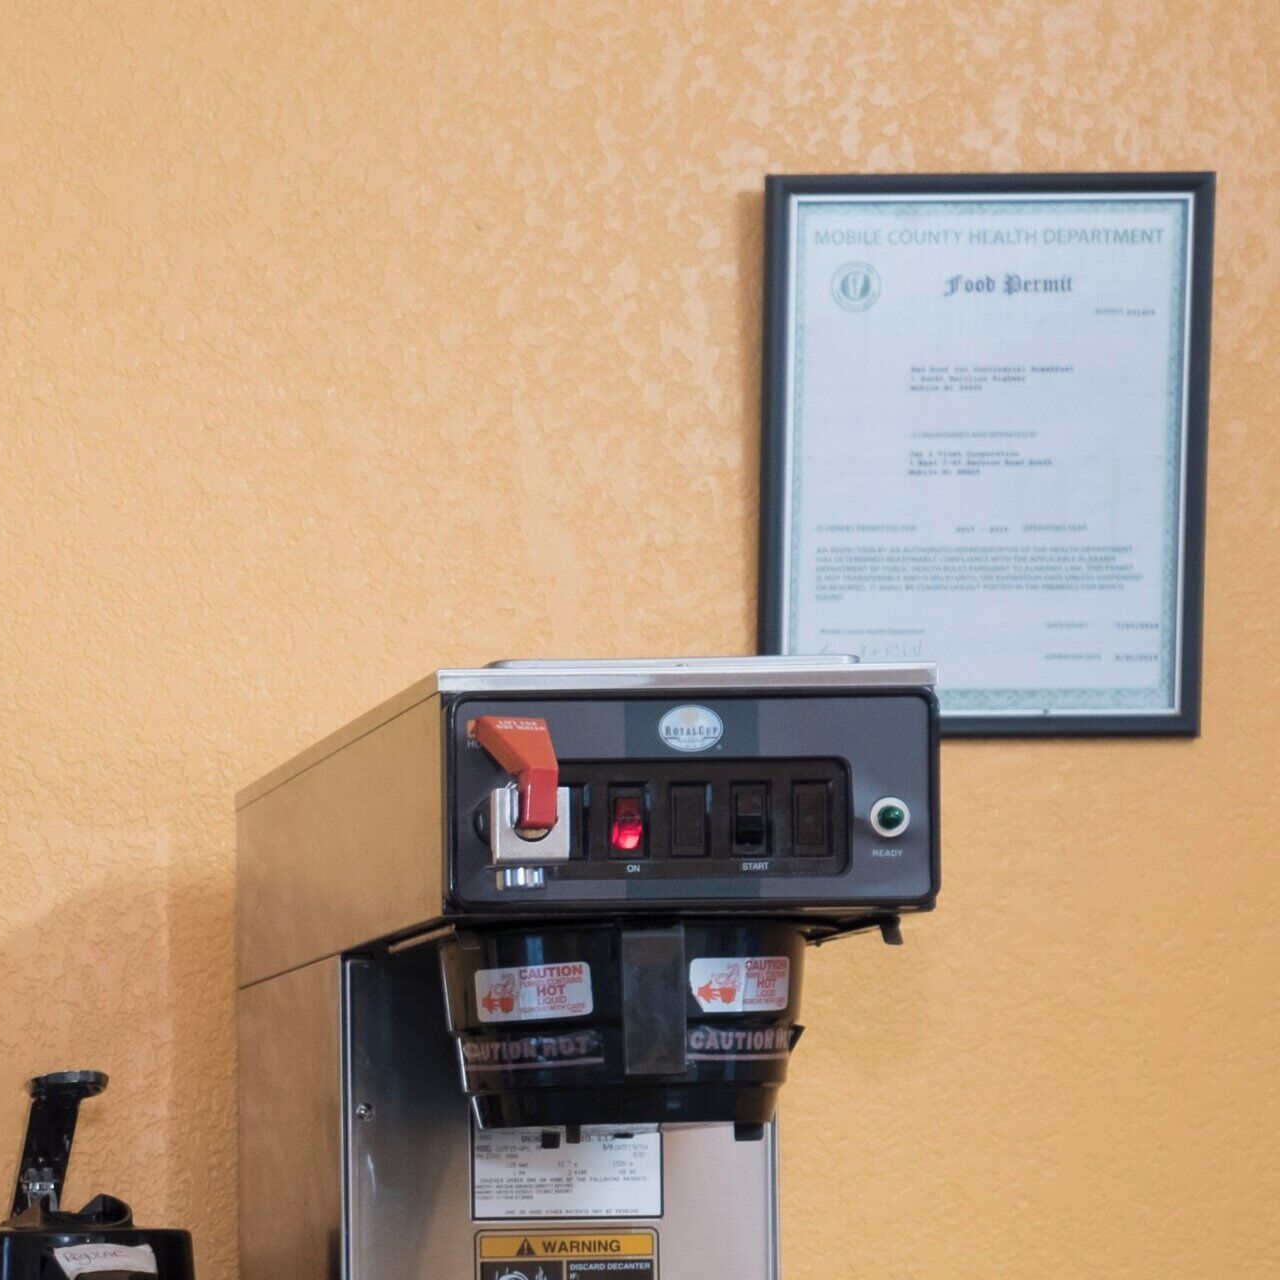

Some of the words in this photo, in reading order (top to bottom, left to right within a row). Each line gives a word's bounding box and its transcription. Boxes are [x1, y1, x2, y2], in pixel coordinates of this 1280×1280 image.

[814, 230, 883, 246] MOBILE
[889, 229, 963, 245] COUNTY
[969, 229, 1037, 245] HEALTH
[1043, 228, 1165, 245] DEPARTMENT
[943, 274, 995, 296] Food
[1003, 274, 1073, 296] Permit
[872, 849, 904, 858] READY
[627, 864, 641, 873] ON
[742, 862, 769, 871] START
[519, 964, 583, 980] CAUTION
[756, 978, 777, 988] HOT
[536, 984, 566, 996] HOT
[537, 995, 567, 1006] LIQUID
[690, 1029, 773, 1050] CAUTION
[542, 1240, 621, 1254] WARNING
[569, 1263, 605, 1271] DISCARD
[607, 1262, 651, 1270] DECANTER
